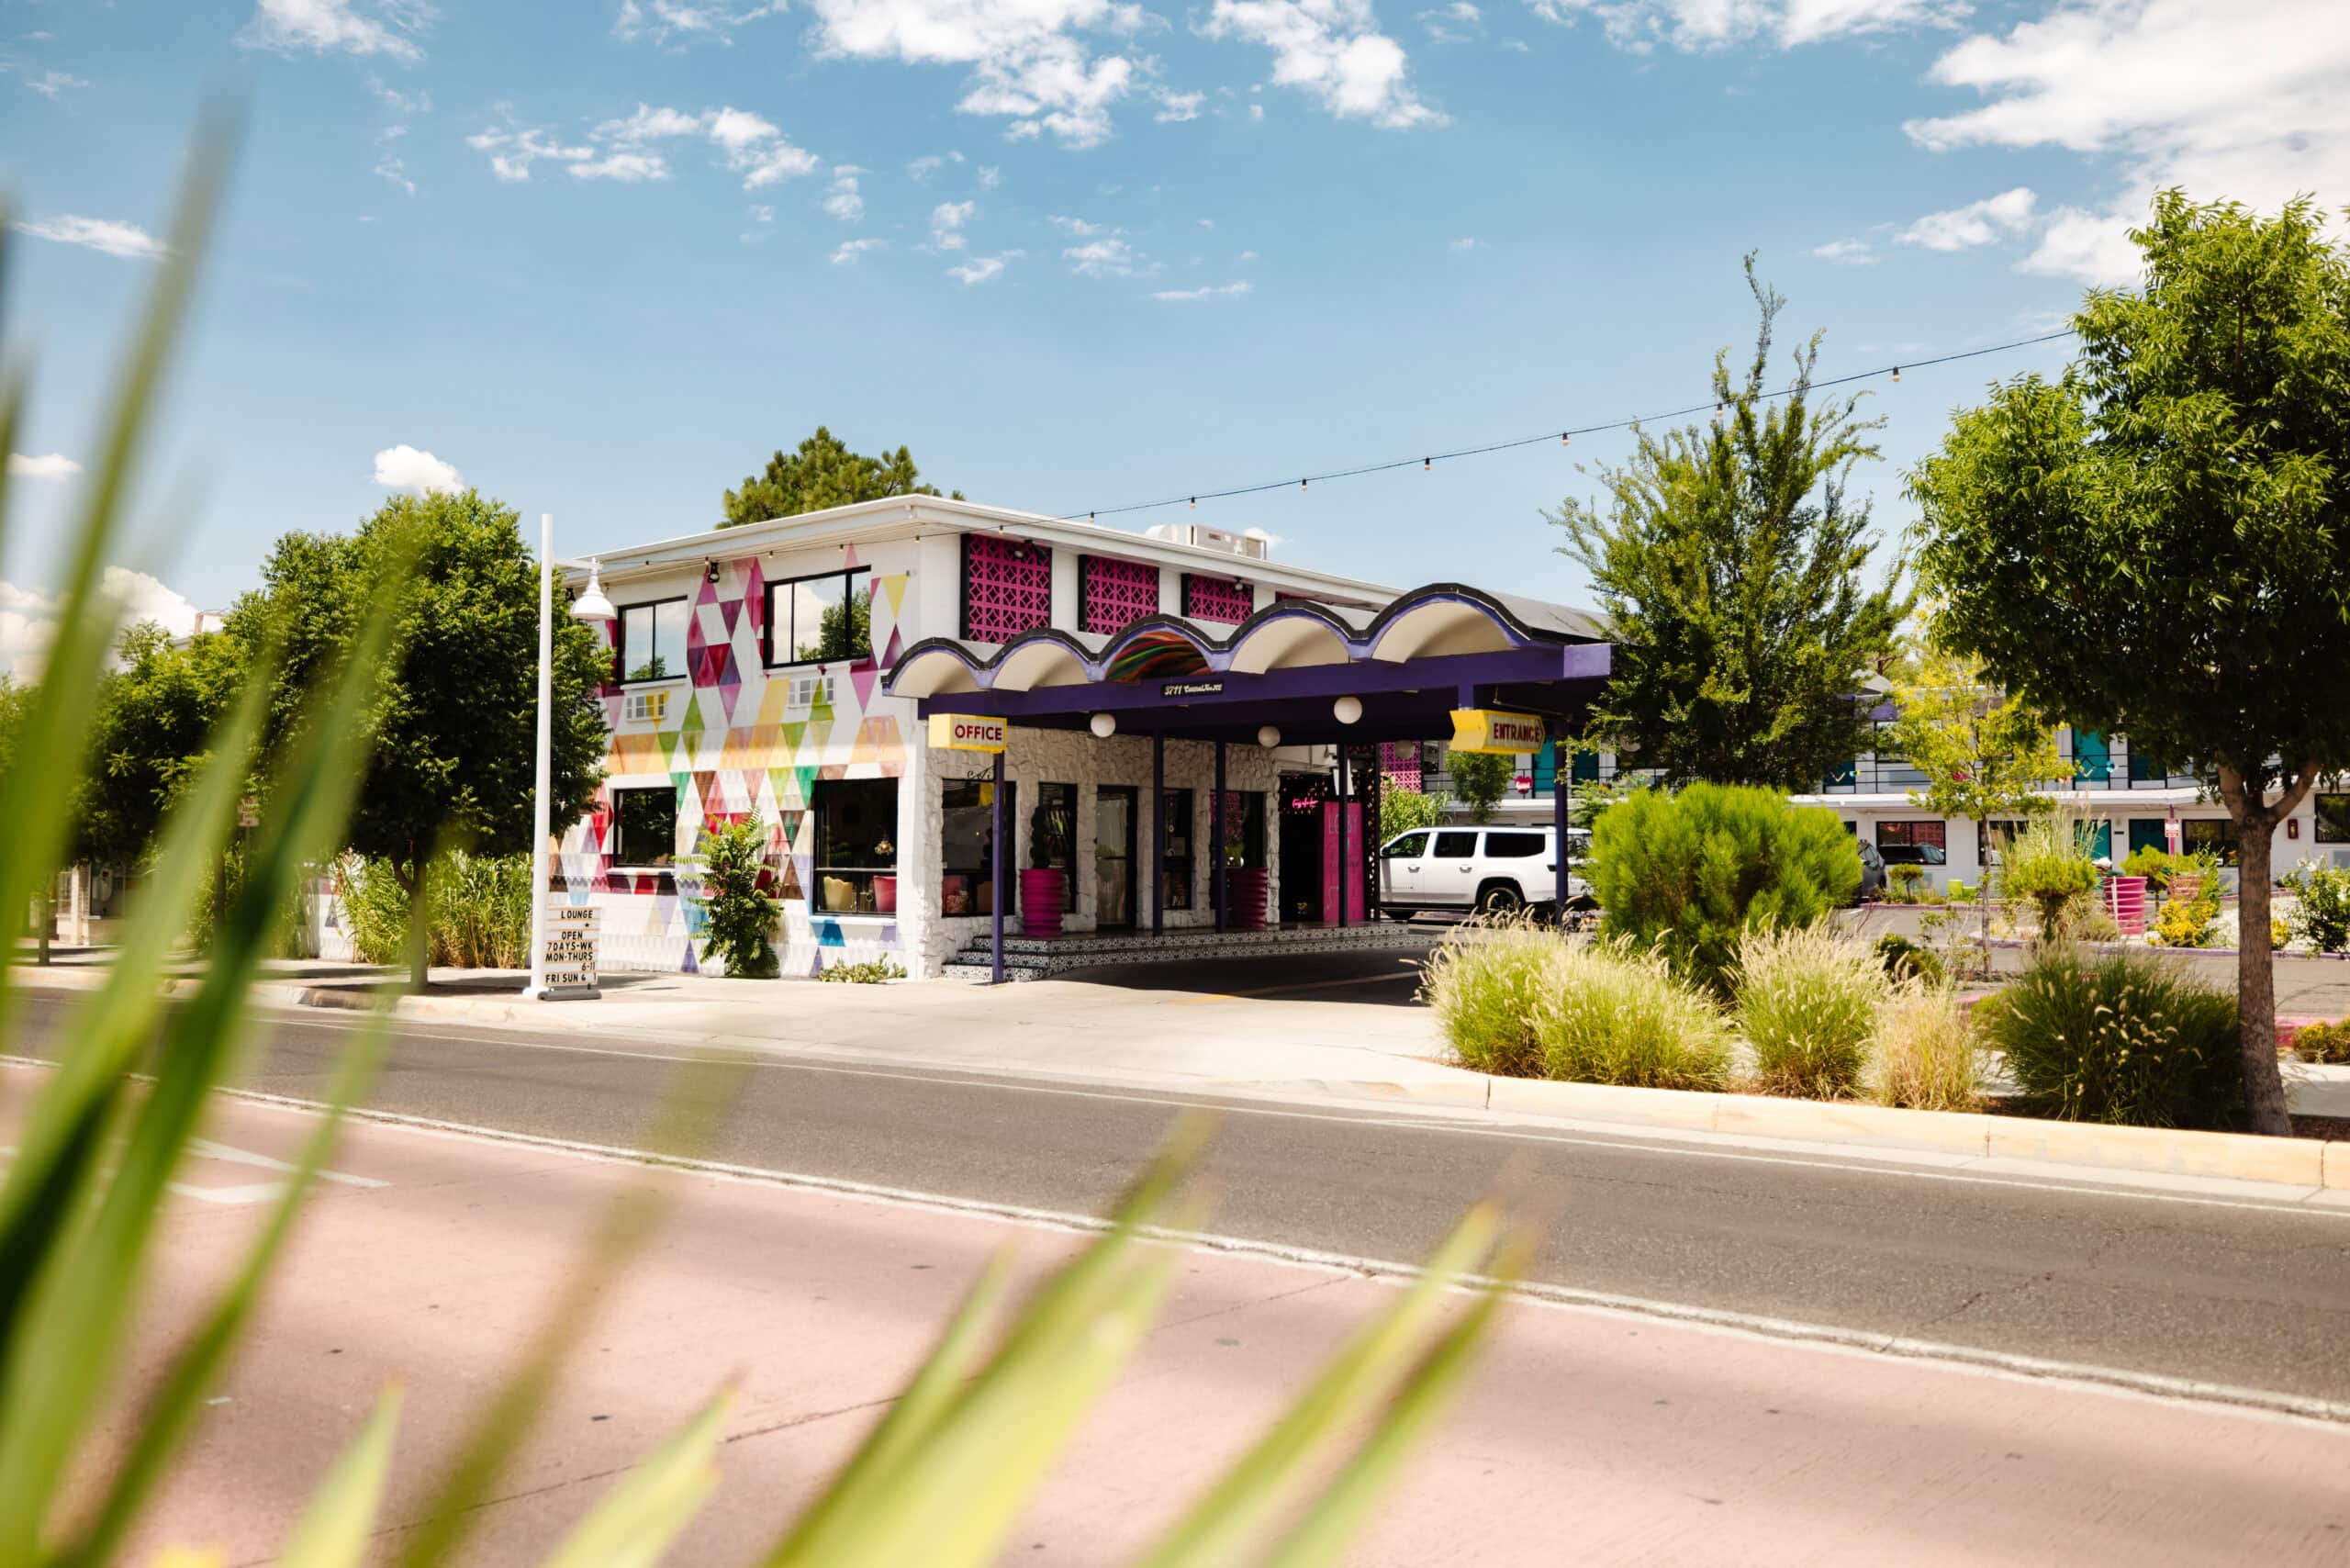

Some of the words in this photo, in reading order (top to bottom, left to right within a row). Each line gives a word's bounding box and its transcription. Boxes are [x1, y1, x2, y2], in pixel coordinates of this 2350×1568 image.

[955, 724, 1002, 741] OFFICE
[1494, 722, 1539, 743] ENTRANCE
[561, 910, 593, 919] LOUNGE
[562, 931, 583, 940] OPEN
[545, 952, 593, 962] MON-THURS
[581, 962, 596, 971] 6-11
[545, 974, 560, 983] FRI
[562, 974, 578, 983] SUN
